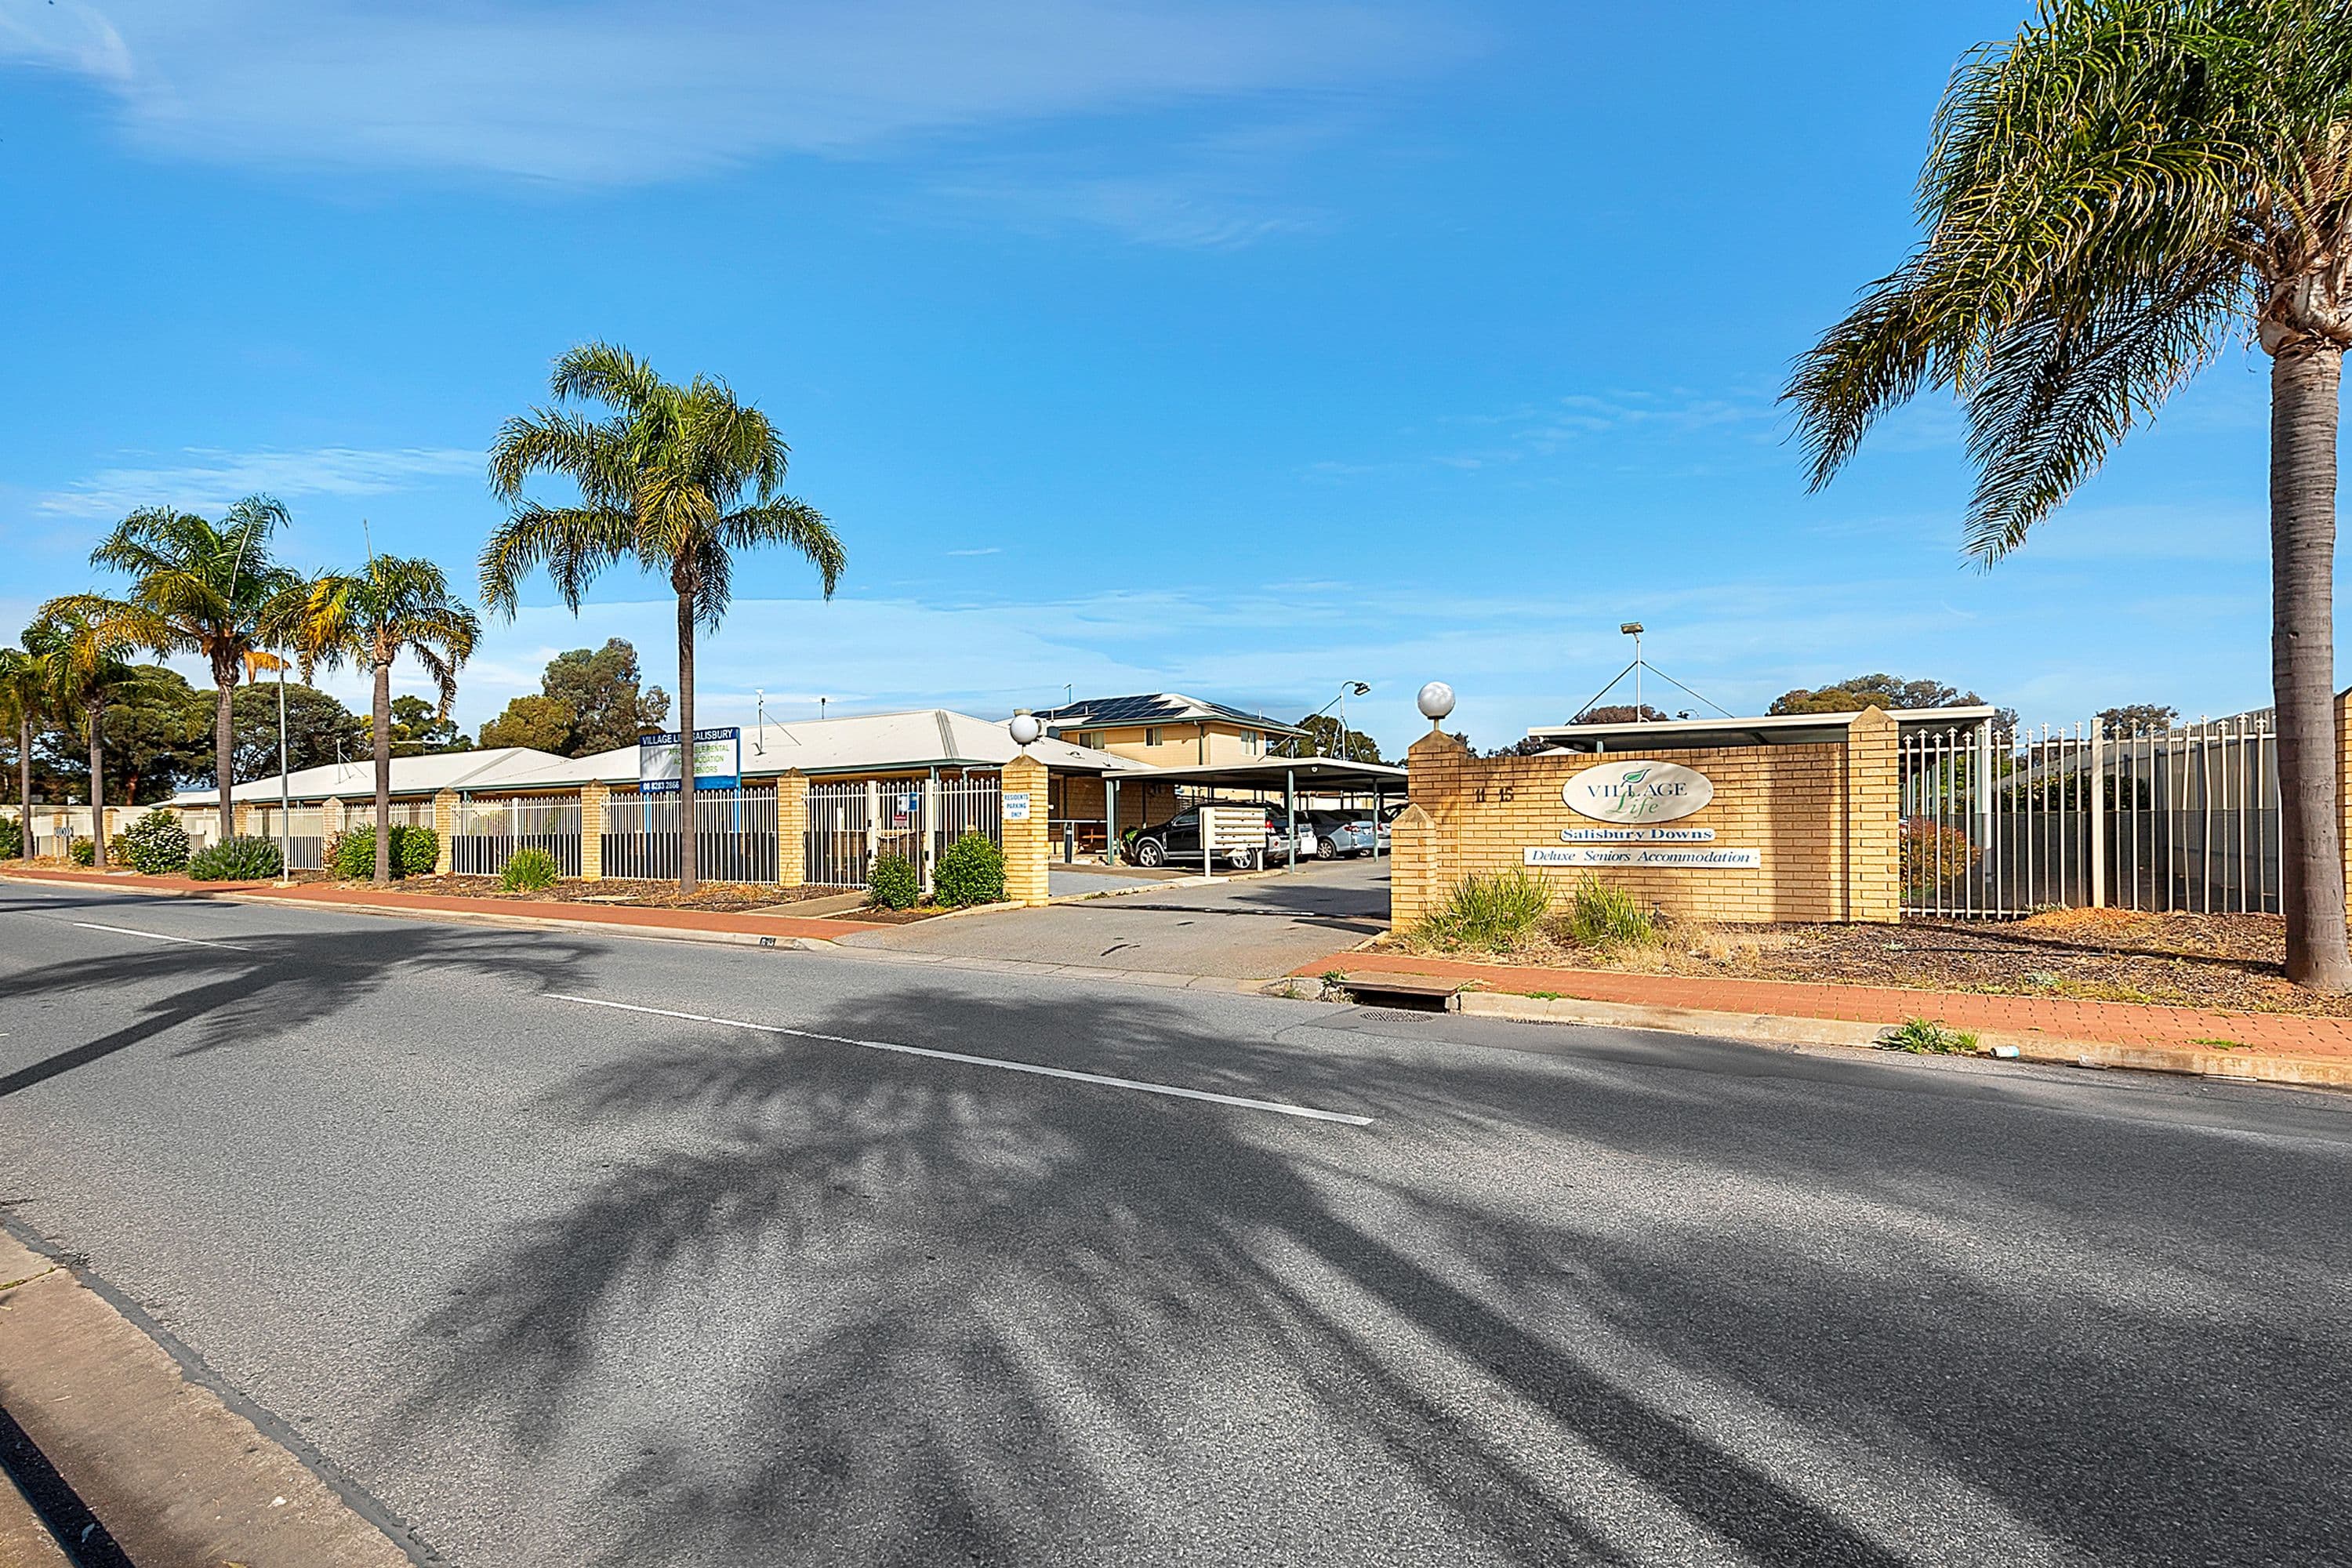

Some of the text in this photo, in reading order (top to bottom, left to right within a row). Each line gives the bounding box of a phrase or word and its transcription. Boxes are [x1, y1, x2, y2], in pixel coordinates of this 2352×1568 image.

[642, 734, 673, 745] VILLAGE
[693, 728, 733, 740] SALISBURY
[706, 744, 730, 753] RENTAL
[1499, 786, 1514, 802] 15
[1588, 782, 1687, 797] VILLAGE
[1606, 790, 1659, 818] Life
[1563, 828, 1713, 841] Salisbury Downs
[1532, 850, 1750, 863] Deluxe Seniors Accommodation
